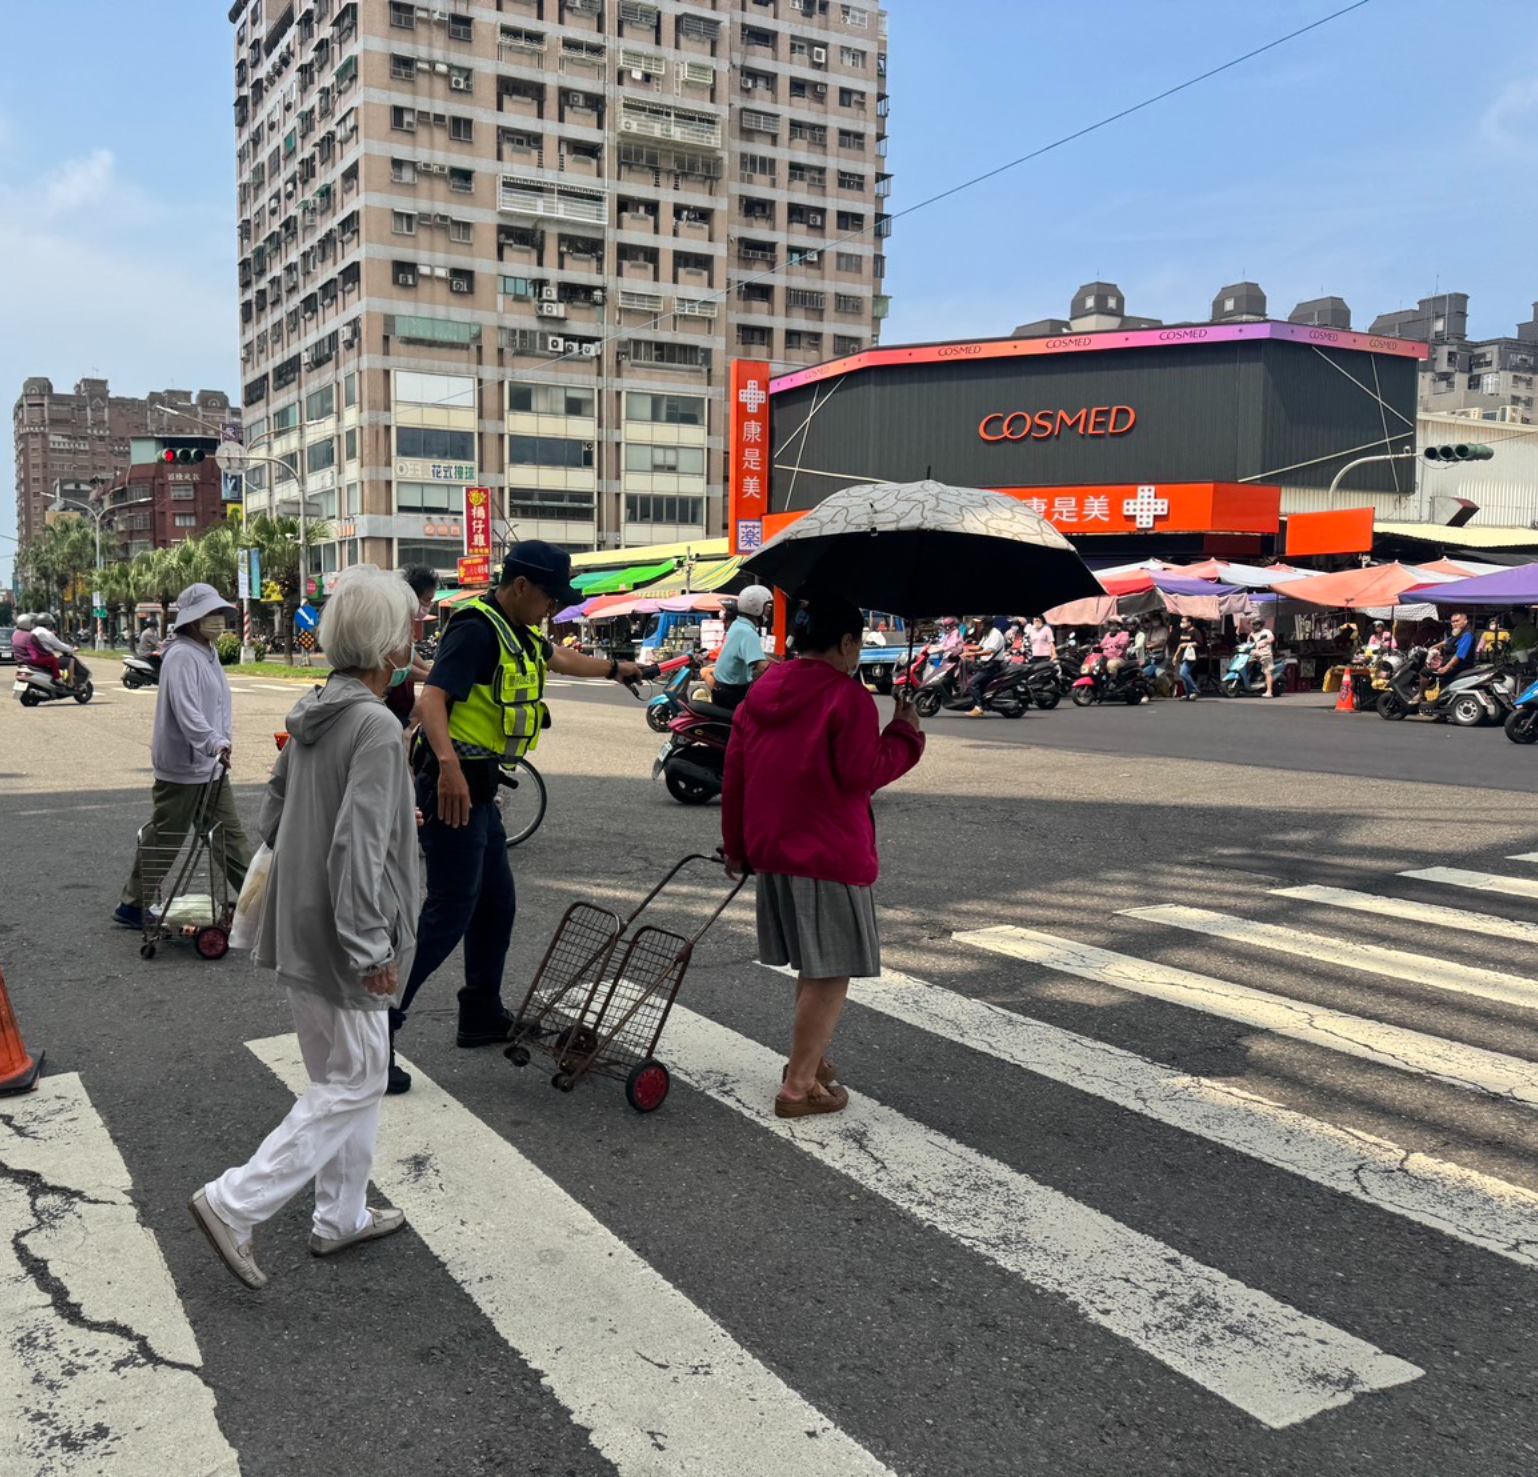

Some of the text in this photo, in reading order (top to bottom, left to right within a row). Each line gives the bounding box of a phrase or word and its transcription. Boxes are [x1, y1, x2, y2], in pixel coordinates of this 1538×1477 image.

[1160, 328, 1208, 341] COSMED
[1309, 329, 1339, 342] COSMED
[1045, 337, 1092, 349] COSMED
[1369, 338, 1397, 350] COSMED
[937, 345, 982, 358] COSMED
[978, 405, 1136, 441] COSMED
[742, 420, 762, 499] 康是美
[432, 464, 474, 479] 花式撞球
